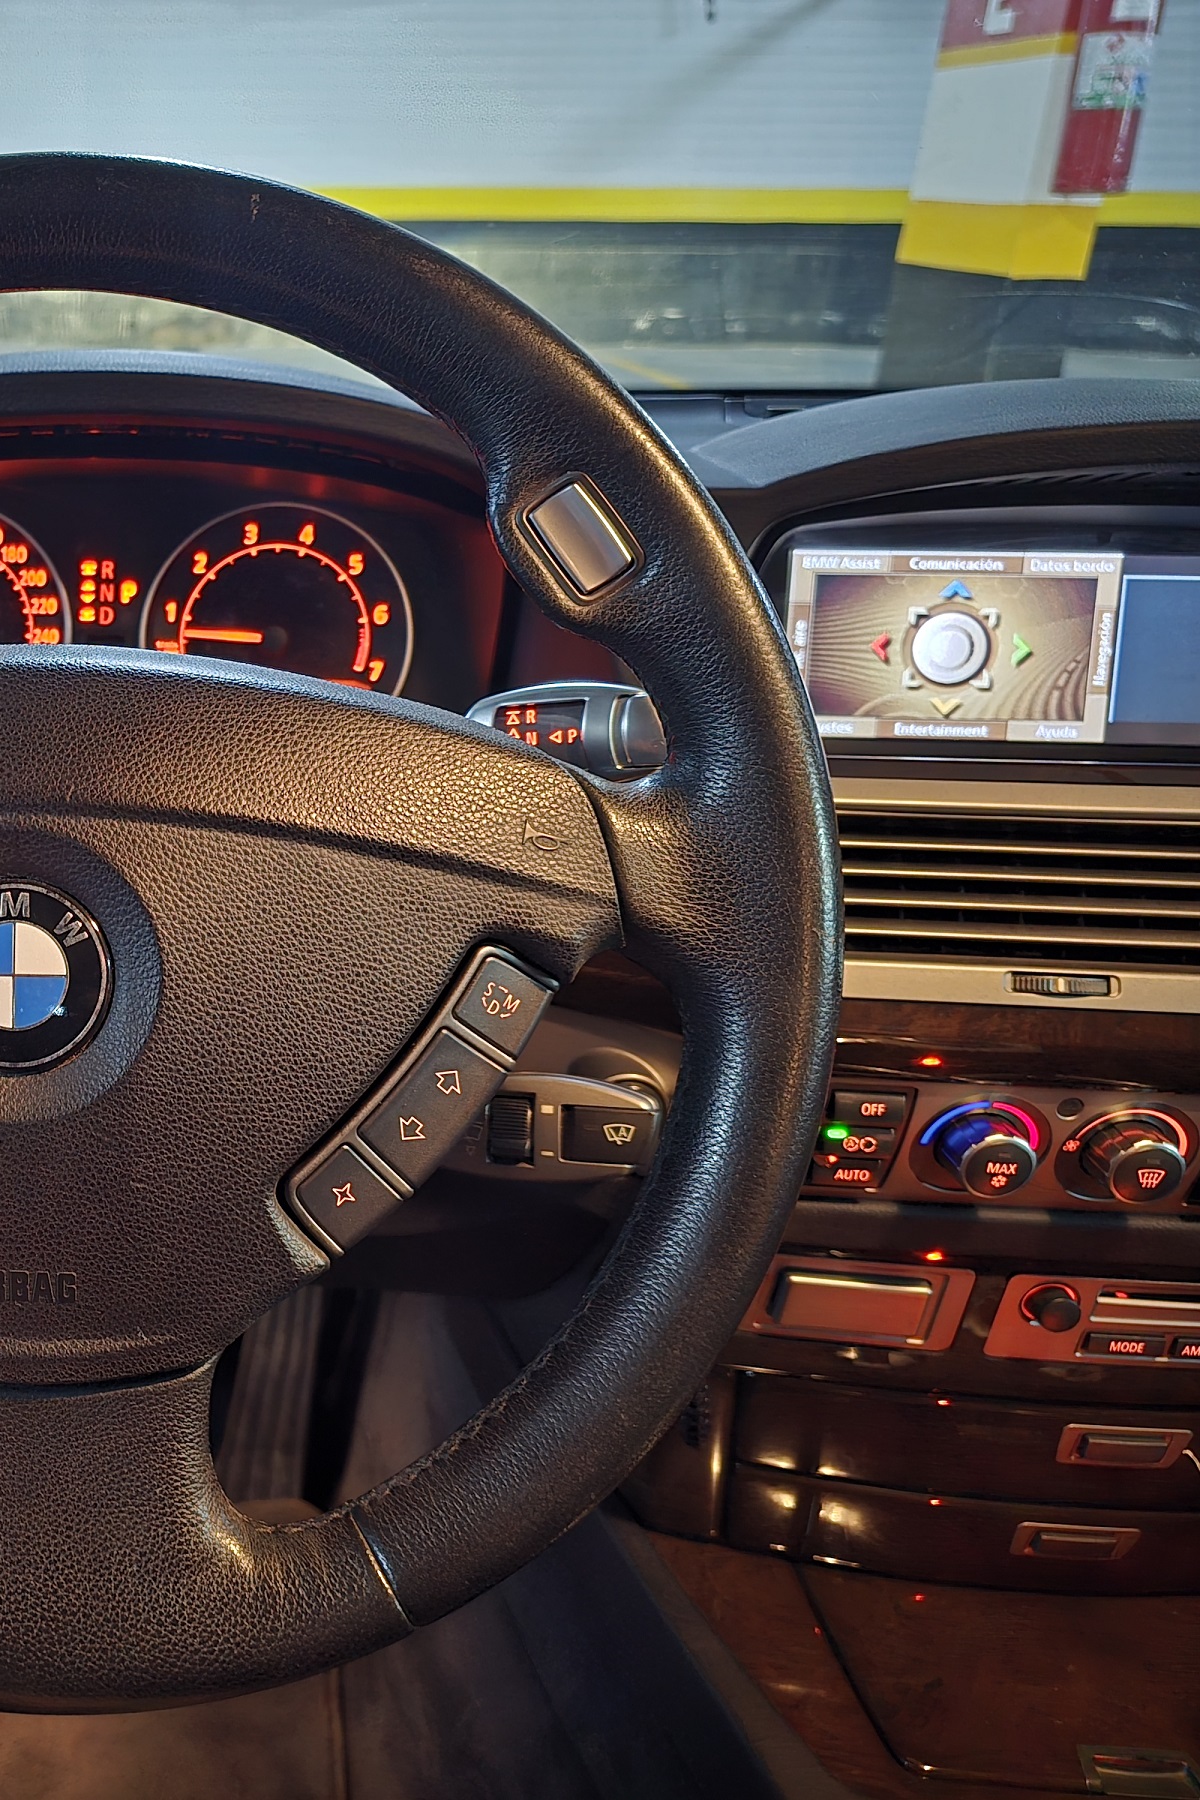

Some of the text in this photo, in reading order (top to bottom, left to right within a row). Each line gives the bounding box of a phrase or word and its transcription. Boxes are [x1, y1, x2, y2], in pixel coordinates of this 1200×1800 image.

[243, 522, 259, 545] 3
[298, 524, 315, 546] 4
[0, 545, 28, 564] 180
[192, 551, 208, 574] 2
[802, 556, 881, 570] BMW Assist
[909, 557, 1005, 571] Comunicación
[101, 560, 115, 580] R
[348, 553, 364, 576] 5
[1030, 559, 1116, 573] Datos bordo
[19, 569, 48, 588] 200
[100, 583, 115, 603] N
[120, 580, 137, 604] P
[30, 597, 59, 616] 220
[100, 606, 115, 625] D
[165, 601, 177, 623] 1
[373, 603, 390, 626] 6
[32, 628, 61, 644] 240
[1092, 612, 1113, 687] Navegación
[368, 660, 385, 683] 7
[525, 709, 536, 724] R
[525, 731, 538, 746] N
[567, 728, 578, 744] P
[894, 722, 989, 737] Entertainment
[1035, 724, 1079, 739] Ayuda
[861, 1102, 887, 1117] OFF
[833, 1168, 871, 1182] AUTO
[986, 1162, 1018, 1175] MAX
[1109, 1340, 1146, 1354] MODE
